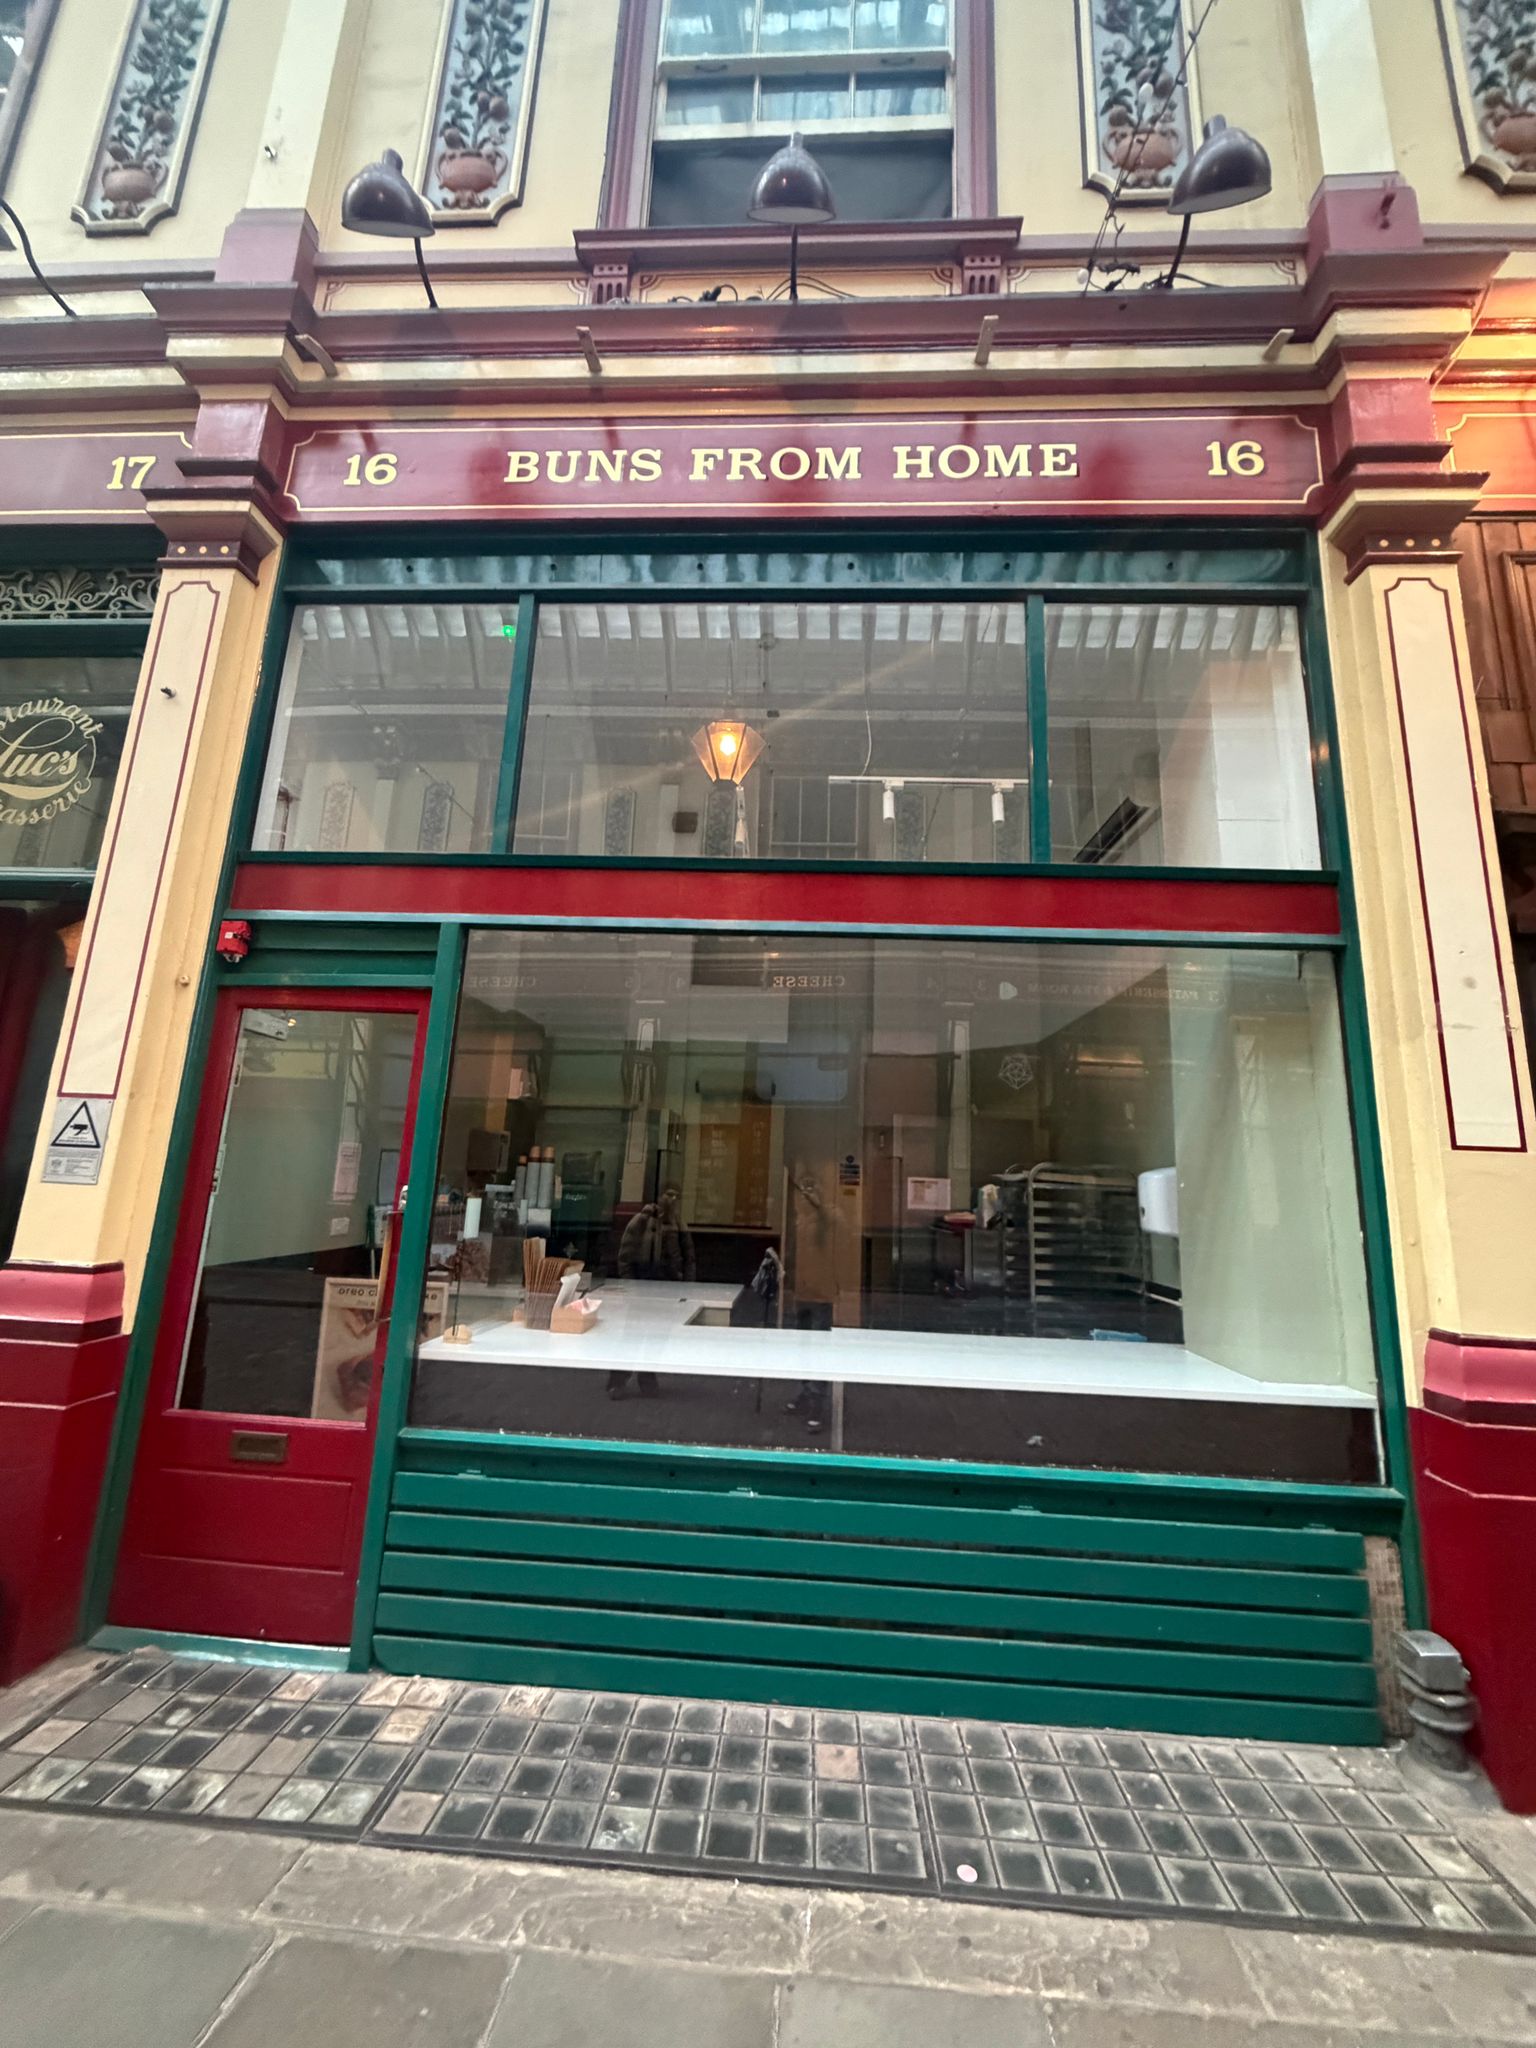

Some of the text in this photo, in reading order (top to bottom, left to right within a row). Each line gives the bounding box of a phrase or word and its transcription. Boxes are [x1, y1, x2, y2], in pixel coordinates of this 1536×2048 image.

[106, 456, 156, 490] 17
[344, 454, 398, 486] 16
[504, 443, 1078, 483] BUNS FROM HOME
[1207, 440, 1266, 477] 16
[0, 697, 104, 737] staurant
[0, 778, 91, 825] asserie
